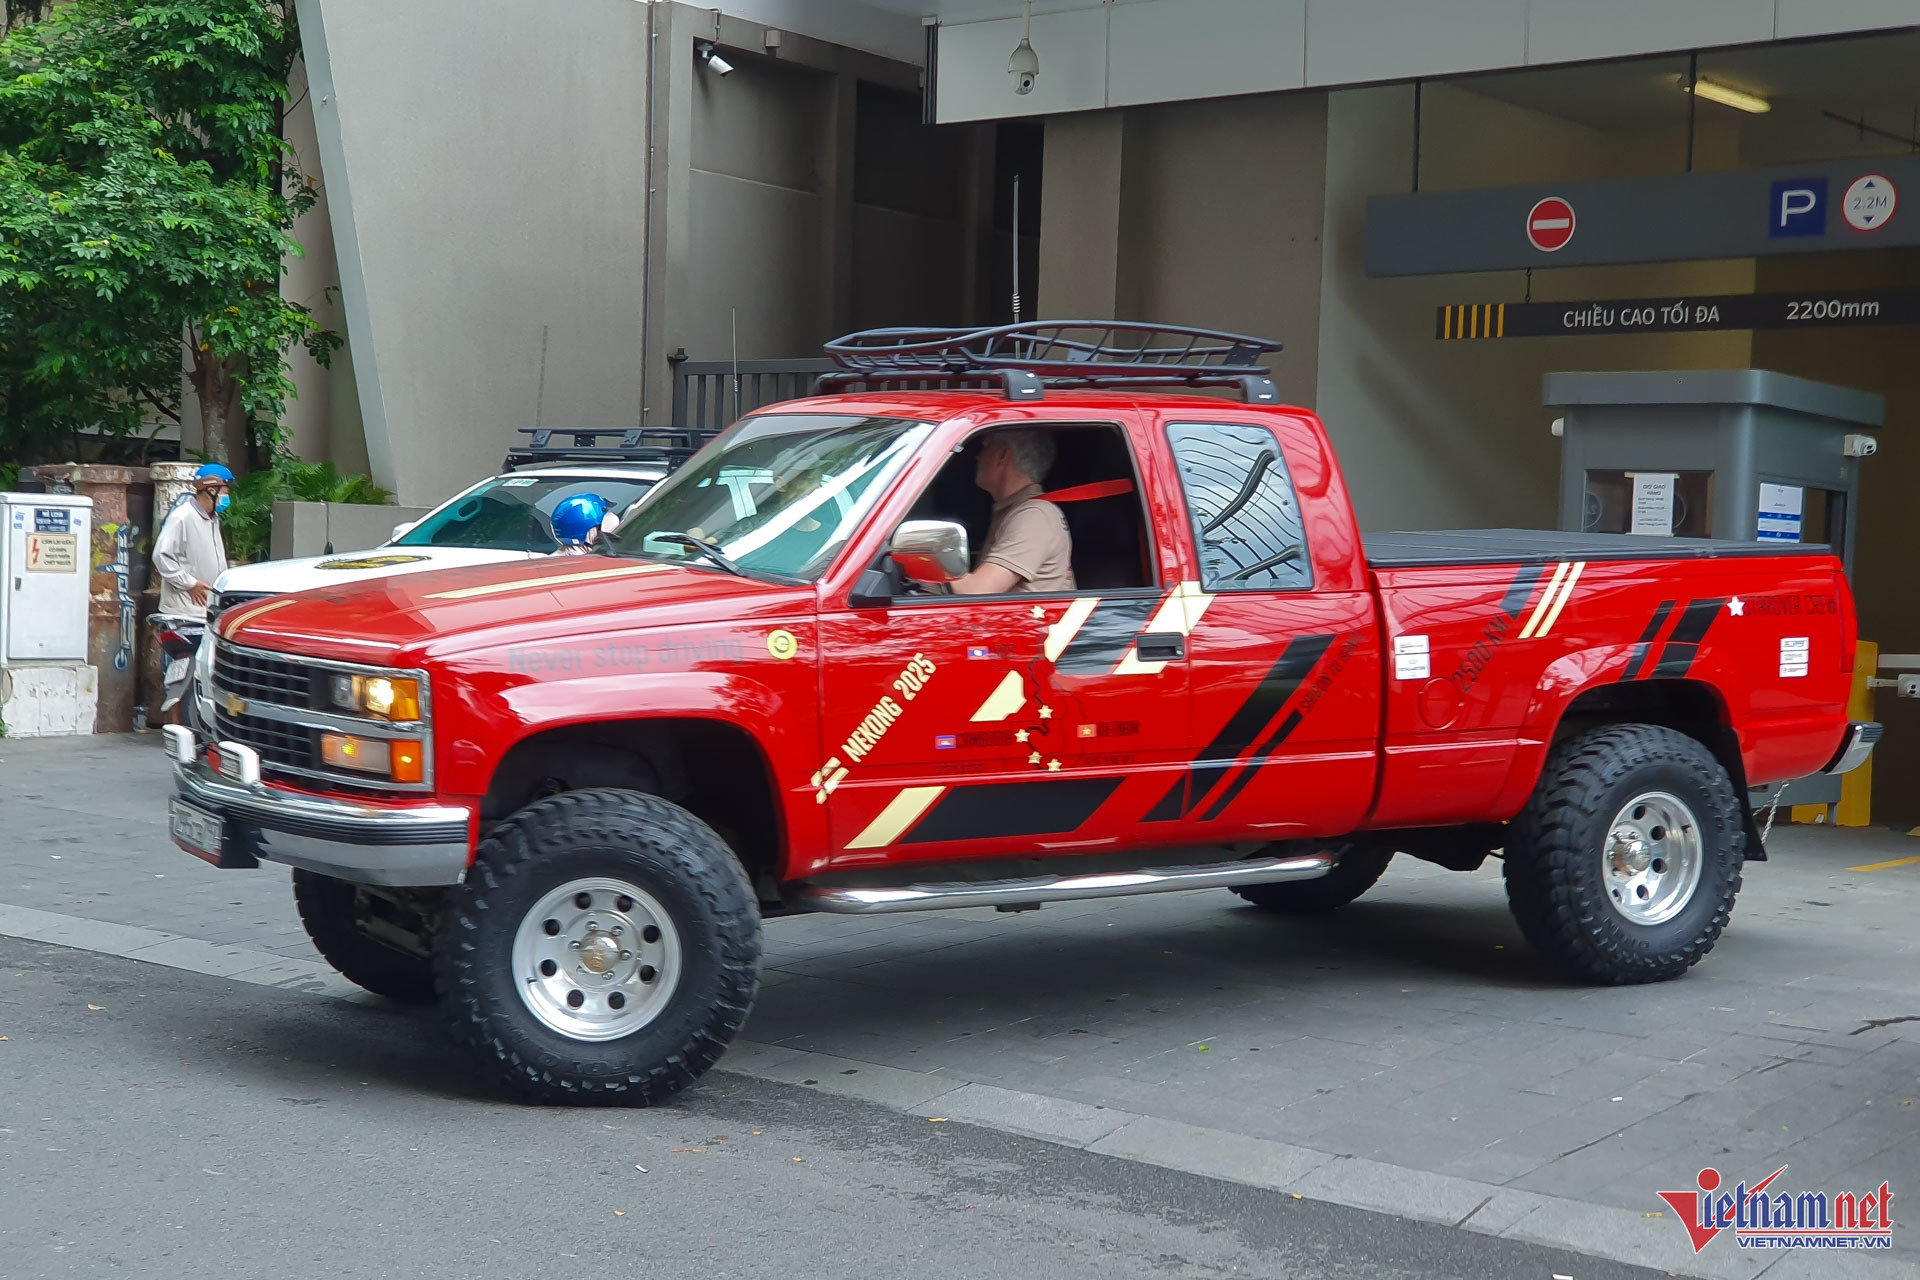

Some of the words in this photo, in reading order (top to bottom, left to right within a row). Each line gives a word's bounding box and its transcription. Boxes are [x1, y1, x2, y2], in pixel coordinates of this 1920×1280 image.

[1781, 190, 1816, 227] P
[1853, 195, 1888, 211] 2.2M
[1563, 303, 1615, 328] CHIỀU
[1620, 307, 1656, 326] CAO
[1660, 300, 1690, 325] TỐI
[1694, 305, 1720, 324] ĐA
[1786, 299, 1880, 320] 2200mm
[508, 647, 584, 673] Never
[593, 643, 648, 670] stop
[657, 634, 745, 665] driving
[1451, 640, 1492, 693] 2500
[1481, 614, 1513, 648] KM
[840, 695, 904, 763] MEKONG
[893, 652, 937, 701] 2025
